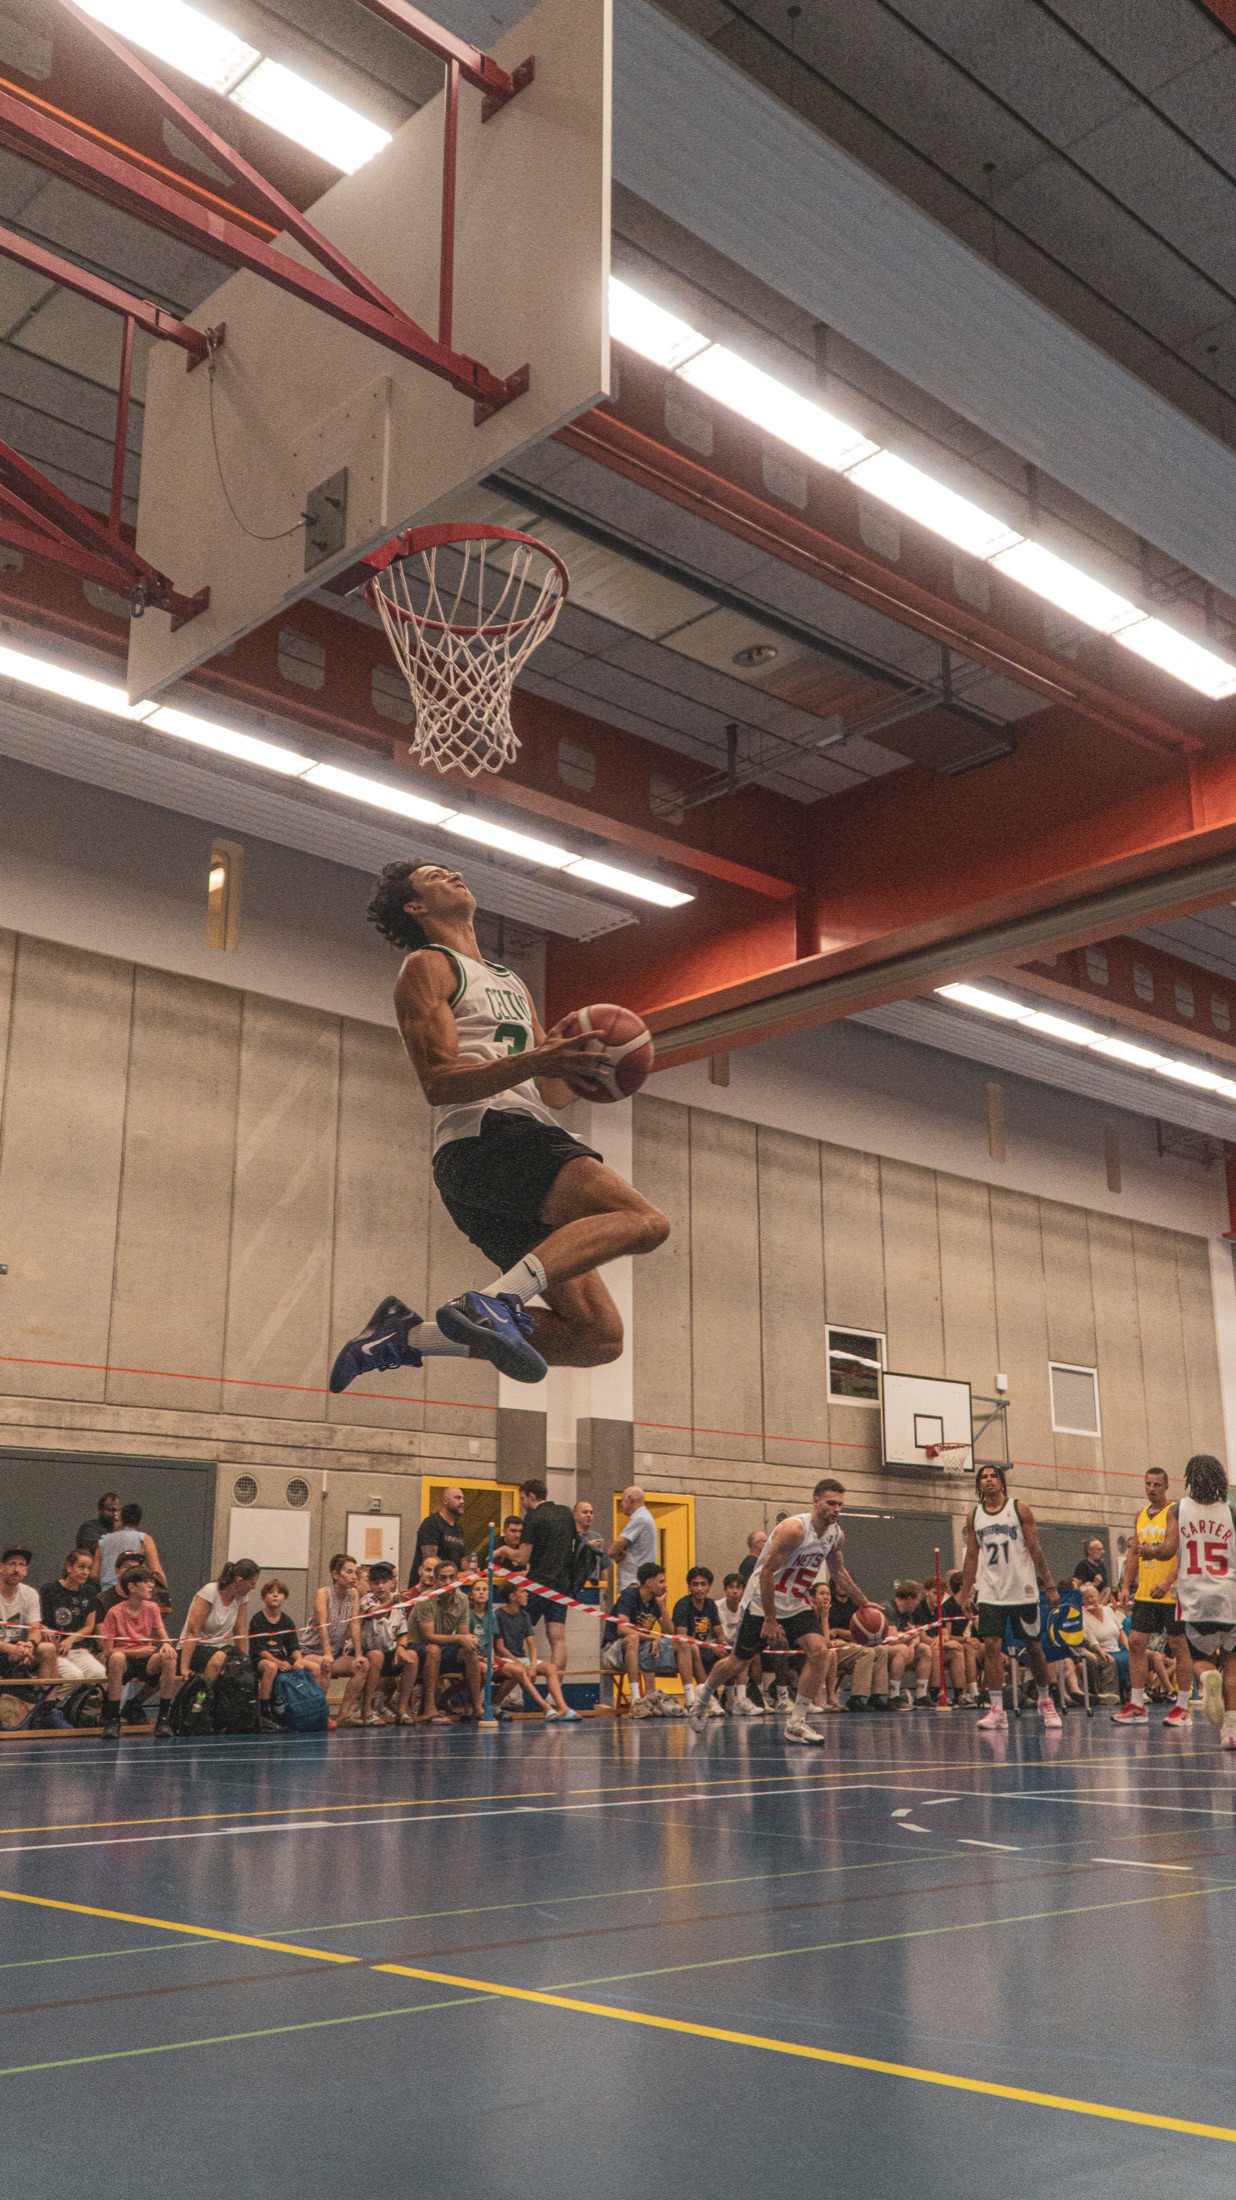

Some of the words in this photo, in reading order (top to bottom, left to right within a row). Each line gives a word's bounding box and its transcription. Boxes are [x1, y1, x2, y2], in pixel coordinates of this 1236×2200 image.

[1180, 1519, 1233, 1542] CARTER
[792, 1553, 824, 1568] NETS
[985, 1540, 1009, 1566] 21
[1186, 1540, 1228, 1576] 15
